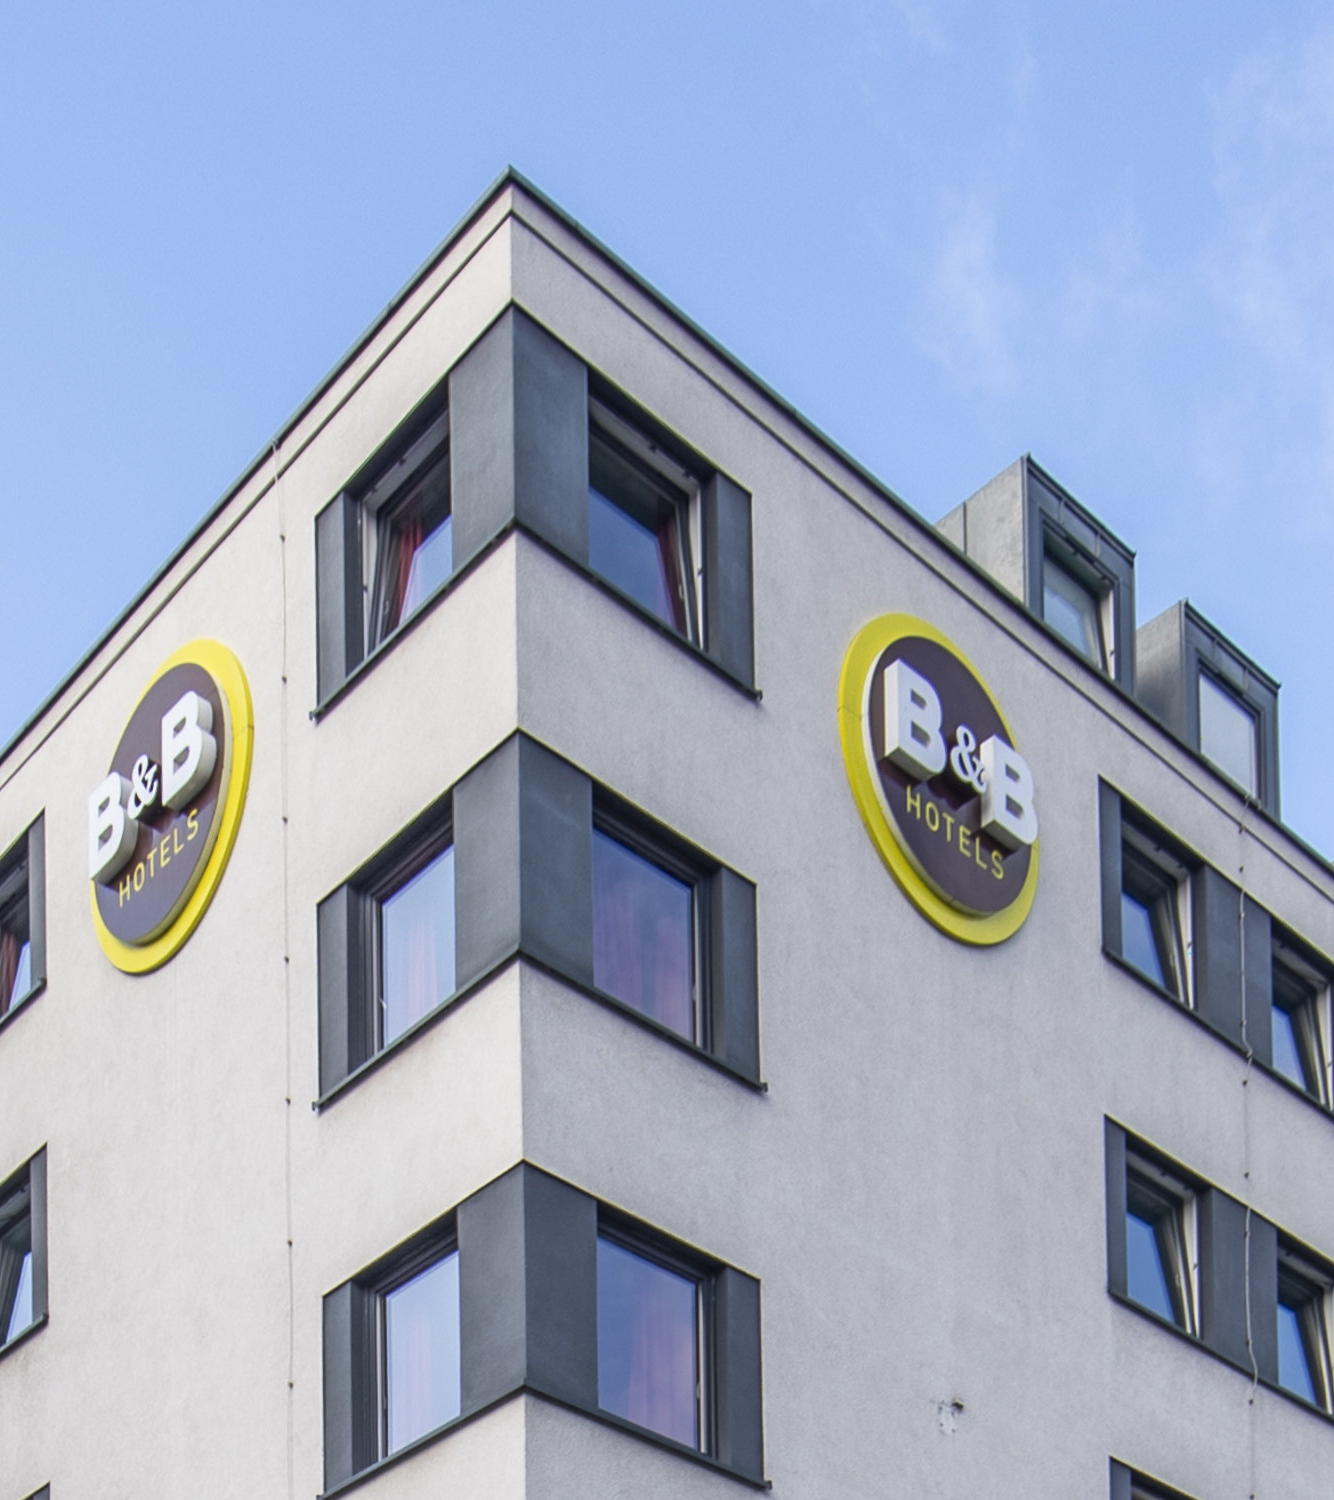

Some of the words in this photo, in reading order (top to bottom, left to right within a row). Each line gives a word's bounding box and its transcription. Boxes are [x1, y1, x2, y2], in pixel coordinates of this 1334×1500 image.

[88, 690, 216, 881] B&B
[884, 657, 1038, 846] B&B
[118, 808, 199, 908] HOTELS
[906, 785, 1004, 880] HOTELS
